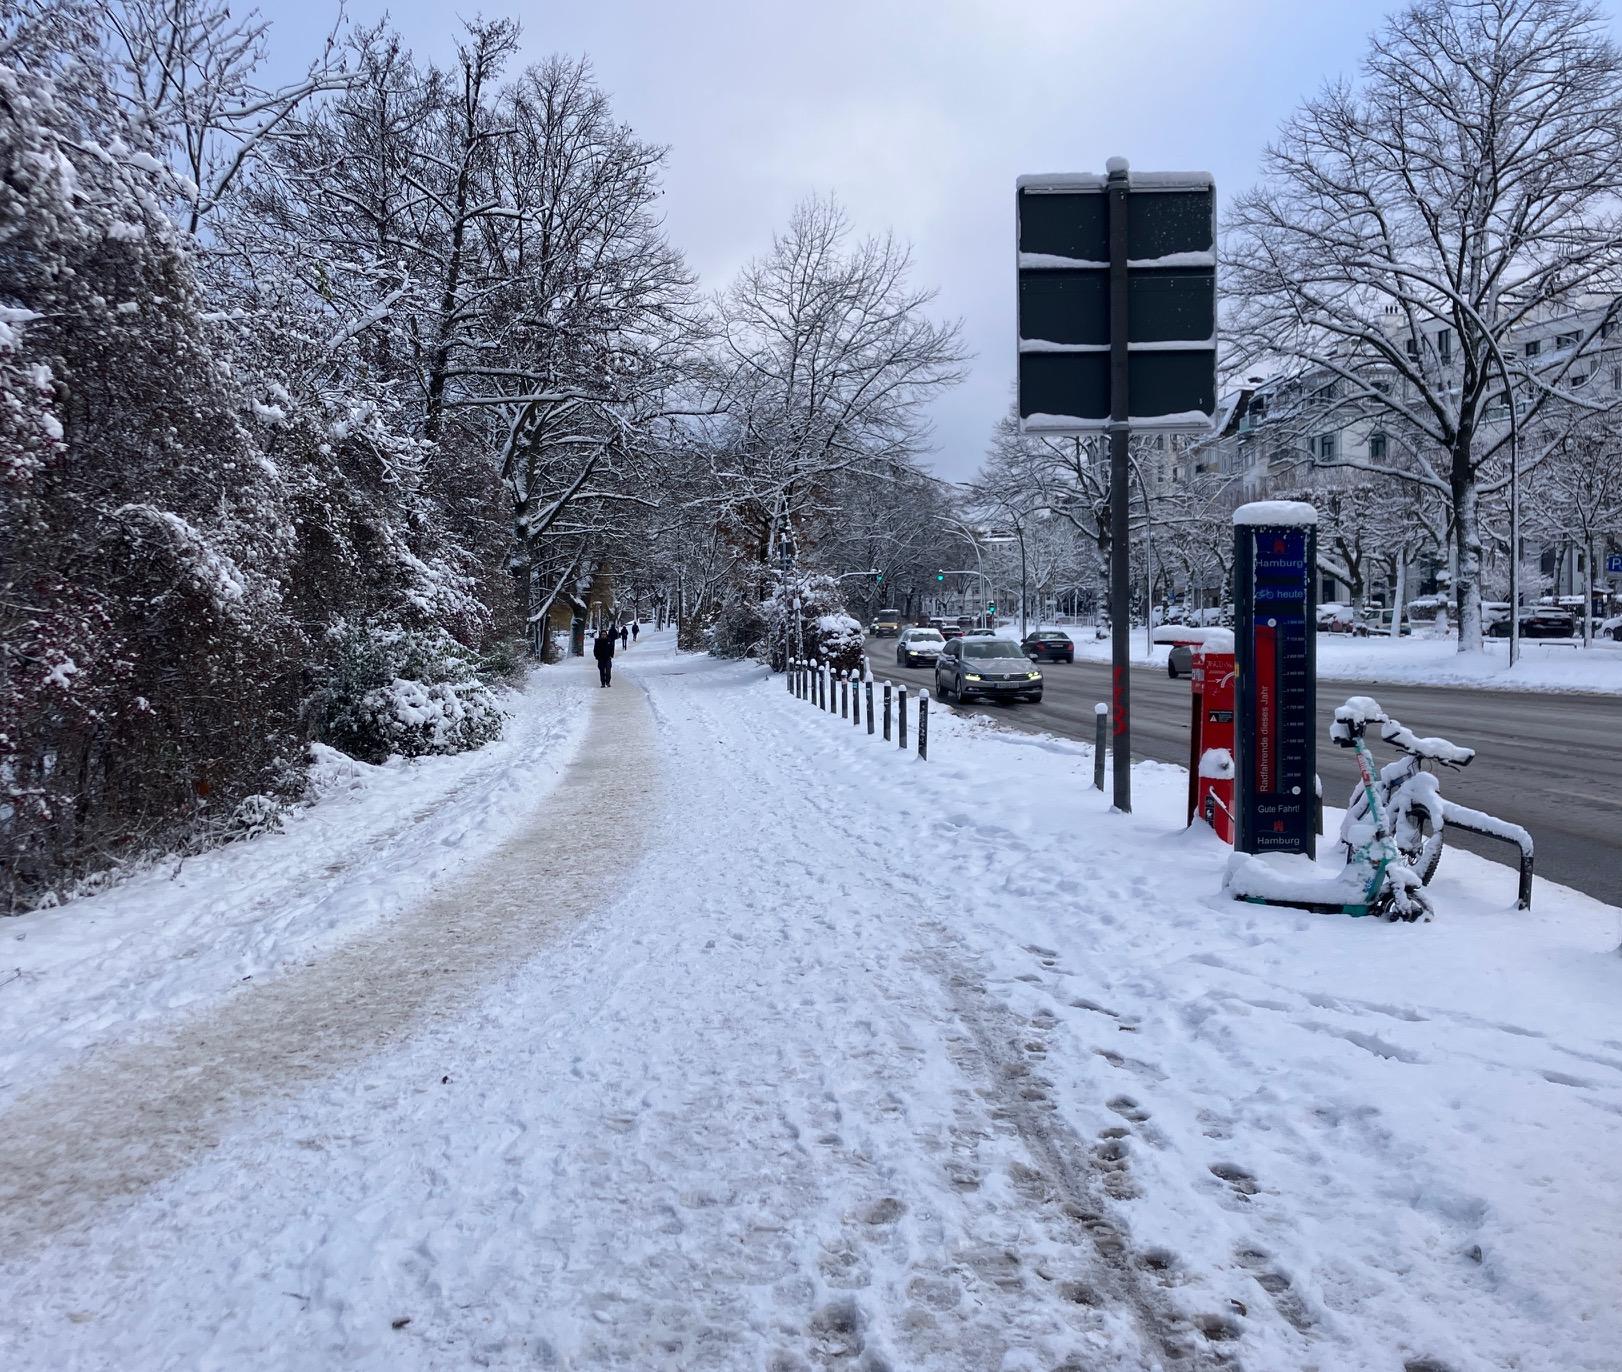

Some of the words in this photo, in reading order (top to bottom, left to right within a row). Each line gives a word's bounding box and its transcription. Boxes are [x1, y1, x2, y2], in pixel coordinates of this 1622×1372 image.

[1256, 559, 1303, 568] Hamburg
[1277, 590, 1303, 598] heute
[1260, 685, 1269, 704] Jahr
[1260, 706, 1269, 735] dieses
[1260, 737, 1269, 792] Radfahrende
[1257, 804, 1276, 813] Gute
[1278, 804, 1300, 813] Fahrt!
[1257, 836, 1300, 846] Hamburg
